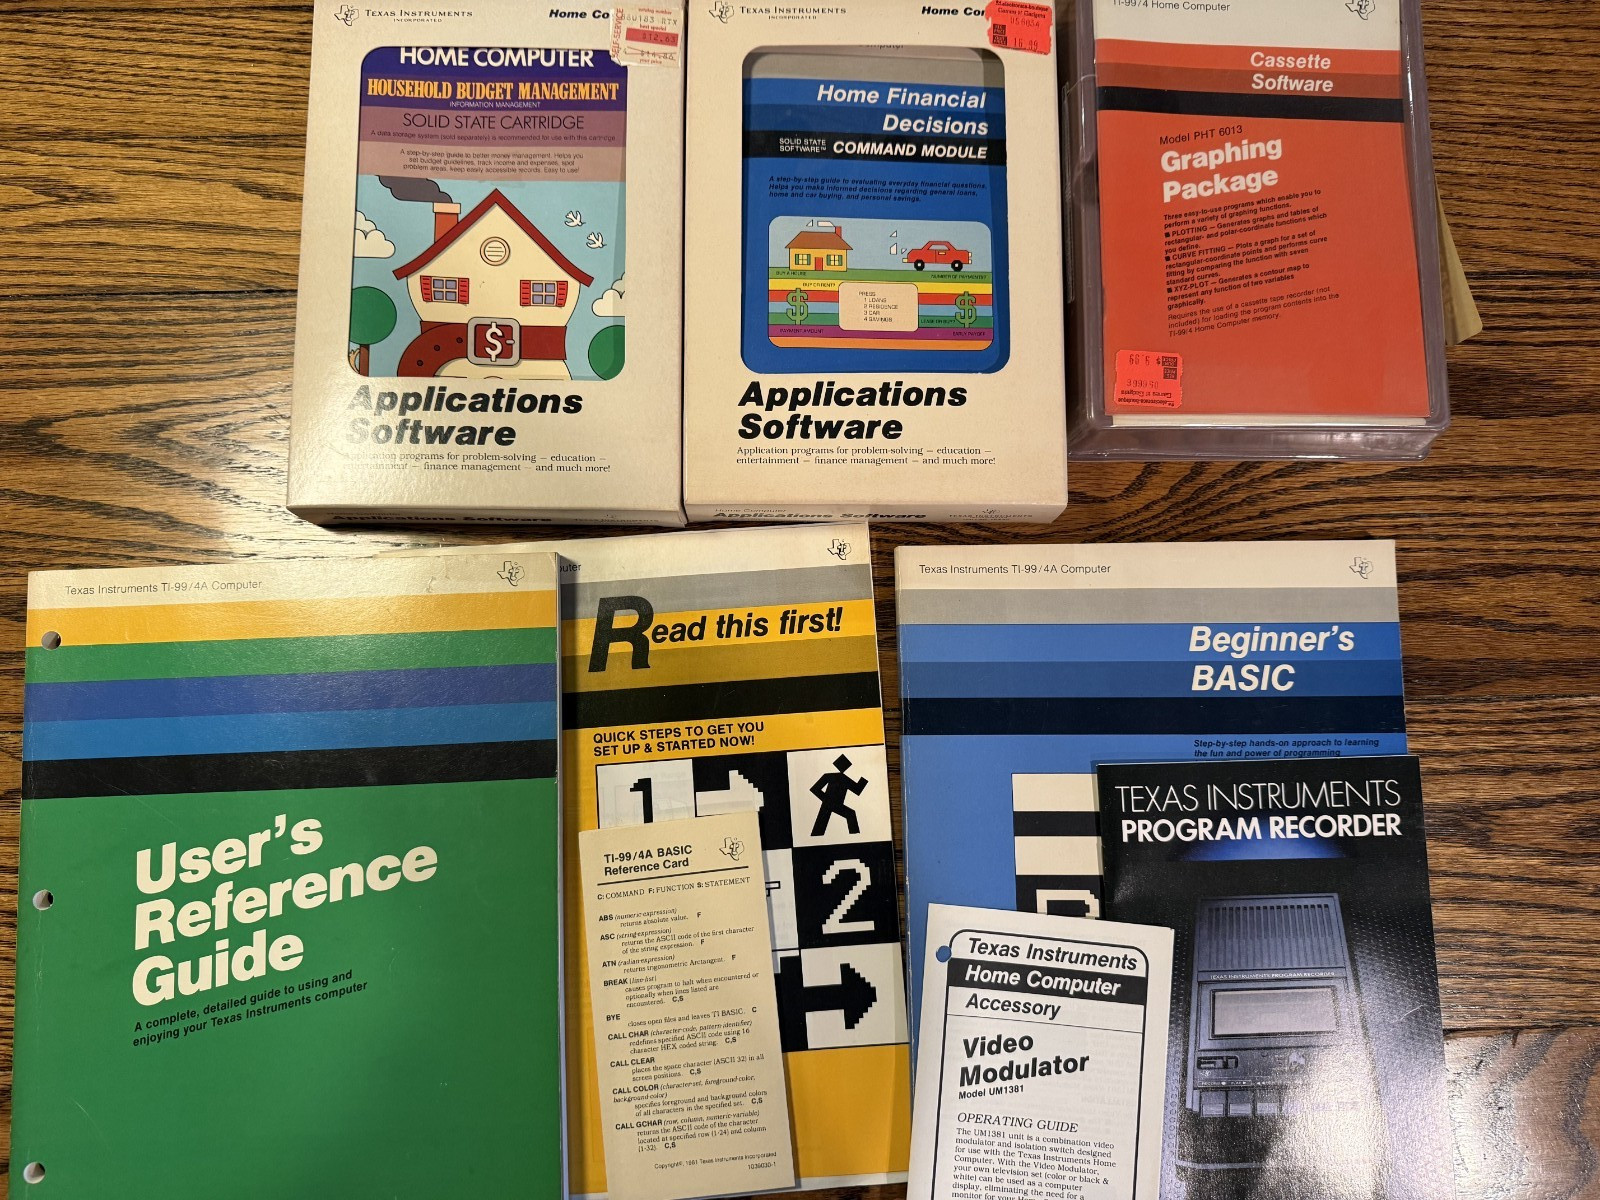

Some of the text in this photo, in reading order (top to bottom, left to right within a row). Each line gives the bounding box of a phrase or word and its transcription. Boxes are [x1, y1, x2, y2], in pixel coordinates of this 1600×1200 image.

[549, 9, 587, 18] Home
[921, 7, 959, 16] Home
[1152, 0, 1230, 12] Home Computer
[400, 47, 594, 66] HOME COMPUTER
[1250, 51, 1331, 70] Cassette
[367, 78, 619, 100] HOUSEHOLD BUDGET MANAGEMENT
[1251, 73, 1334, 92] Software
[817, 84, 986, 108] Home Financial
[402, 112, 584, 129] SOLID STATE CARTRIDGE
[882, 114, 989, 136] Decisions
[779, 137, 801, 146] SOLID
[1159, 124, 1242, 145] Model PHT 6013
[833, 140, 987, 158] COMMAND MODULE
[1160, 138, 1282, 173] Graphing
[1163, 169, 1278, 203] Package
[1183, 206, 1222, 217] easy-to-use
[1223, 200, 1254, 210] programs
[1255, 196, 1276, 205] which
[1277, 192, 1299, 201] enable
[348, 384, 583, 415] Applications
[738, 381, 967, 411] Applications
[345, 418, 516, 446] Software
[738, 414, 902, 440] Software
[736, 445, 980, 457] Application programs for problem-solving education
[814, 455, 847, 464] finance
[850, 457, 907, 466] management
[942, 456, 967, 464] much
[918, 564, 1111, 574] Texas Instruments TI-99/4A Computer
[64, 580, 262, 595] Texas Instruments TI-99/4A Computer
[588, 596, 843, 673] Read this first!
[1191, 665, 1296, 692] BASIC
[593, 721, 764, 743] QUICK STEPS TO GET YOU
[1193, 739, 1247, 748] Step-by-step
[1291, 738, 1331, 748] approach
[1344, 738, 1379, 747] learning
[593, 735, 754, 756] SET UP & STARTED NOW!
[1210, 749, 1223, 757] fun
[1226, 749, 1242, 757] and
[1244, 750, 1270, 759] power
[1273, 748, 1282, 757] of
[1284, 750, 1341, 759] programming
[1114, 779, 1400, 812] TEXAS INSTRUMENTS
[1121, 813, 1402, 842] PROGRAM RECORDER
[603, 844, 692, 863] TI-99/4A BASIC
[604, 857, 689, 876] Reference Card
[135, 846, 438, 950] Reference
[822, 858, 874, 934] 2
[968, 937, 1138, 970] Texas Instruments
[132, 928, 304, 1006] Guide
[603, 978, 628, 987] BREAK
[964, 964, 1121, 995] Home Computer
[134, 969, 352, 1032] A complete, detailed guide to using and
[966, 993, 1060, 1020] Accessory
[132, 981, 367, 1046] enjoying your Texas Instruments computer
[963, 1034, 1034, 1058] Video
[610, 1057, 655, 1068] CALL CLEAR
[959, 1054, 1090, 1087] Modulator
[958, 1084, 1023, 1099] Model UM1381
[957, 1112, 1078, 1132] OPERATING GUIDE
[956, 1127, 971, 1135] The
[974, 1129, 1005, 1138] UM1381
[1042, 1136, 1090, 1146] combination
